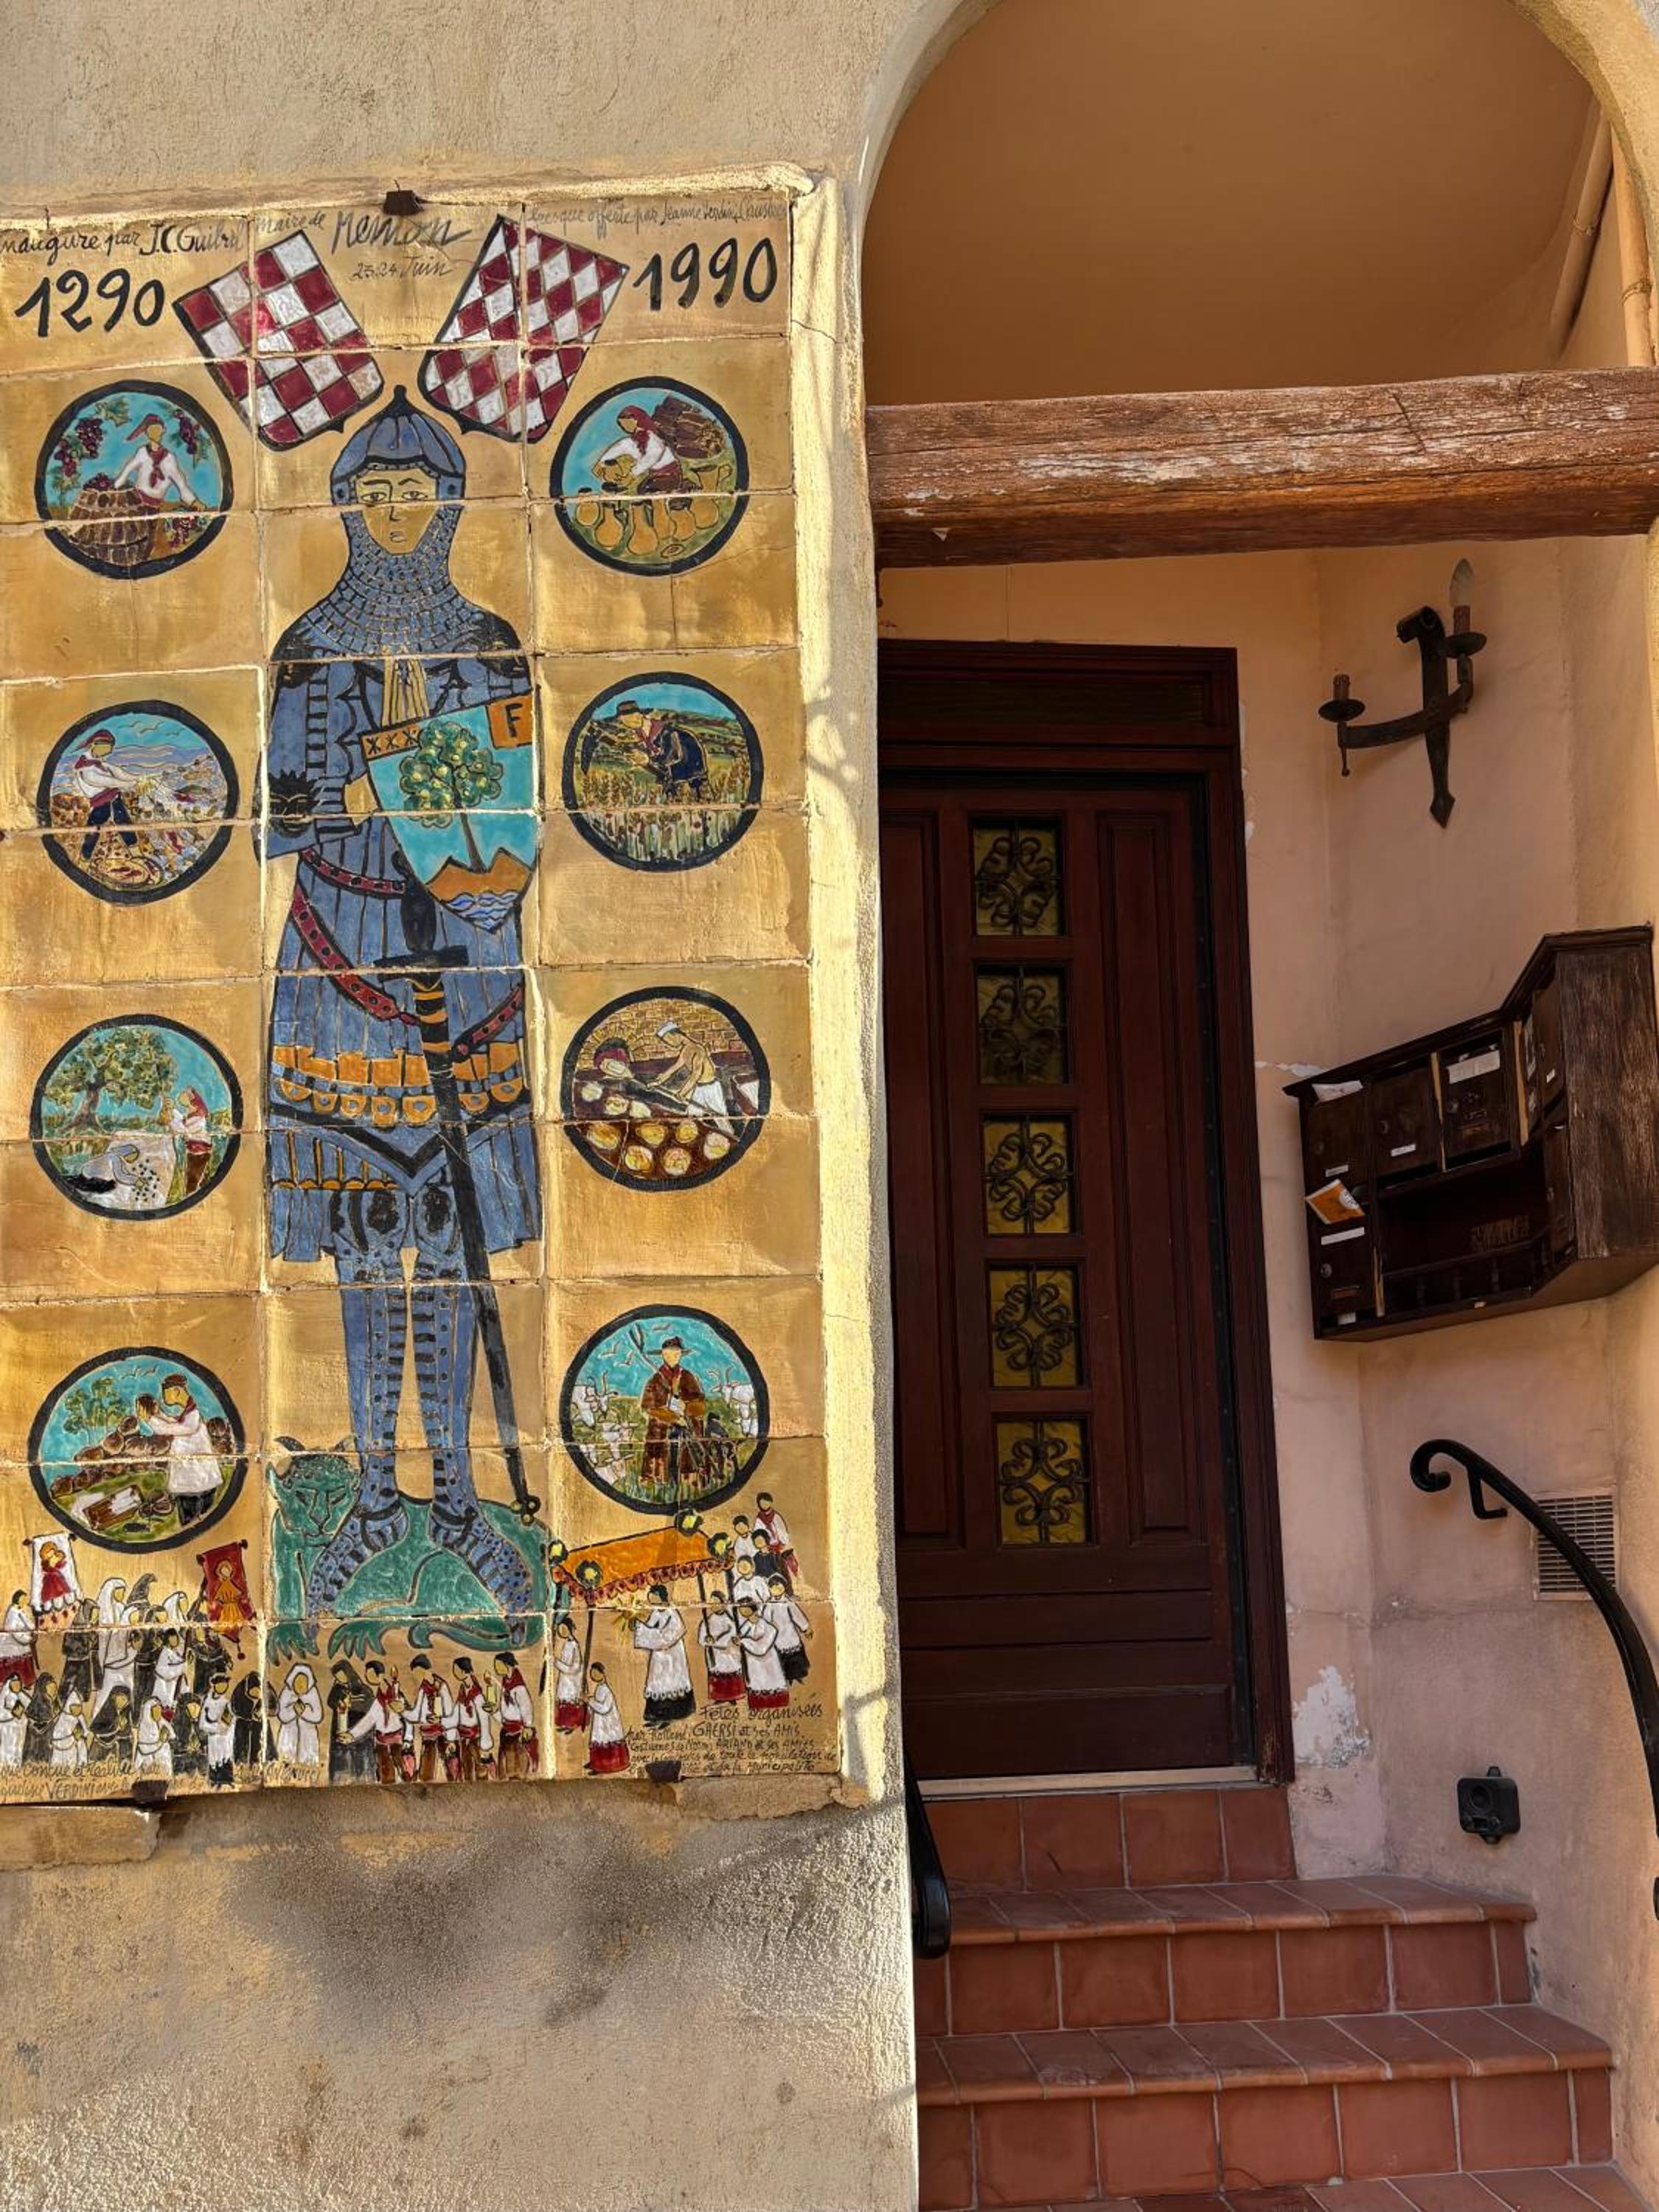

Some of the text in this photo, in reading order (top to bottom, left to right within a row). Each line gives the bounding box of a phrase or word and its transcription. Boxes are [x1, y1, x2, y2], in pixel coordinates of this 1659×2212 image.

[0, 231, 100, 266] naugure
[105, 231, 140, 257] par
[633, 237, 779, 311] 1990
[14, 268, 165, 338] 1290
